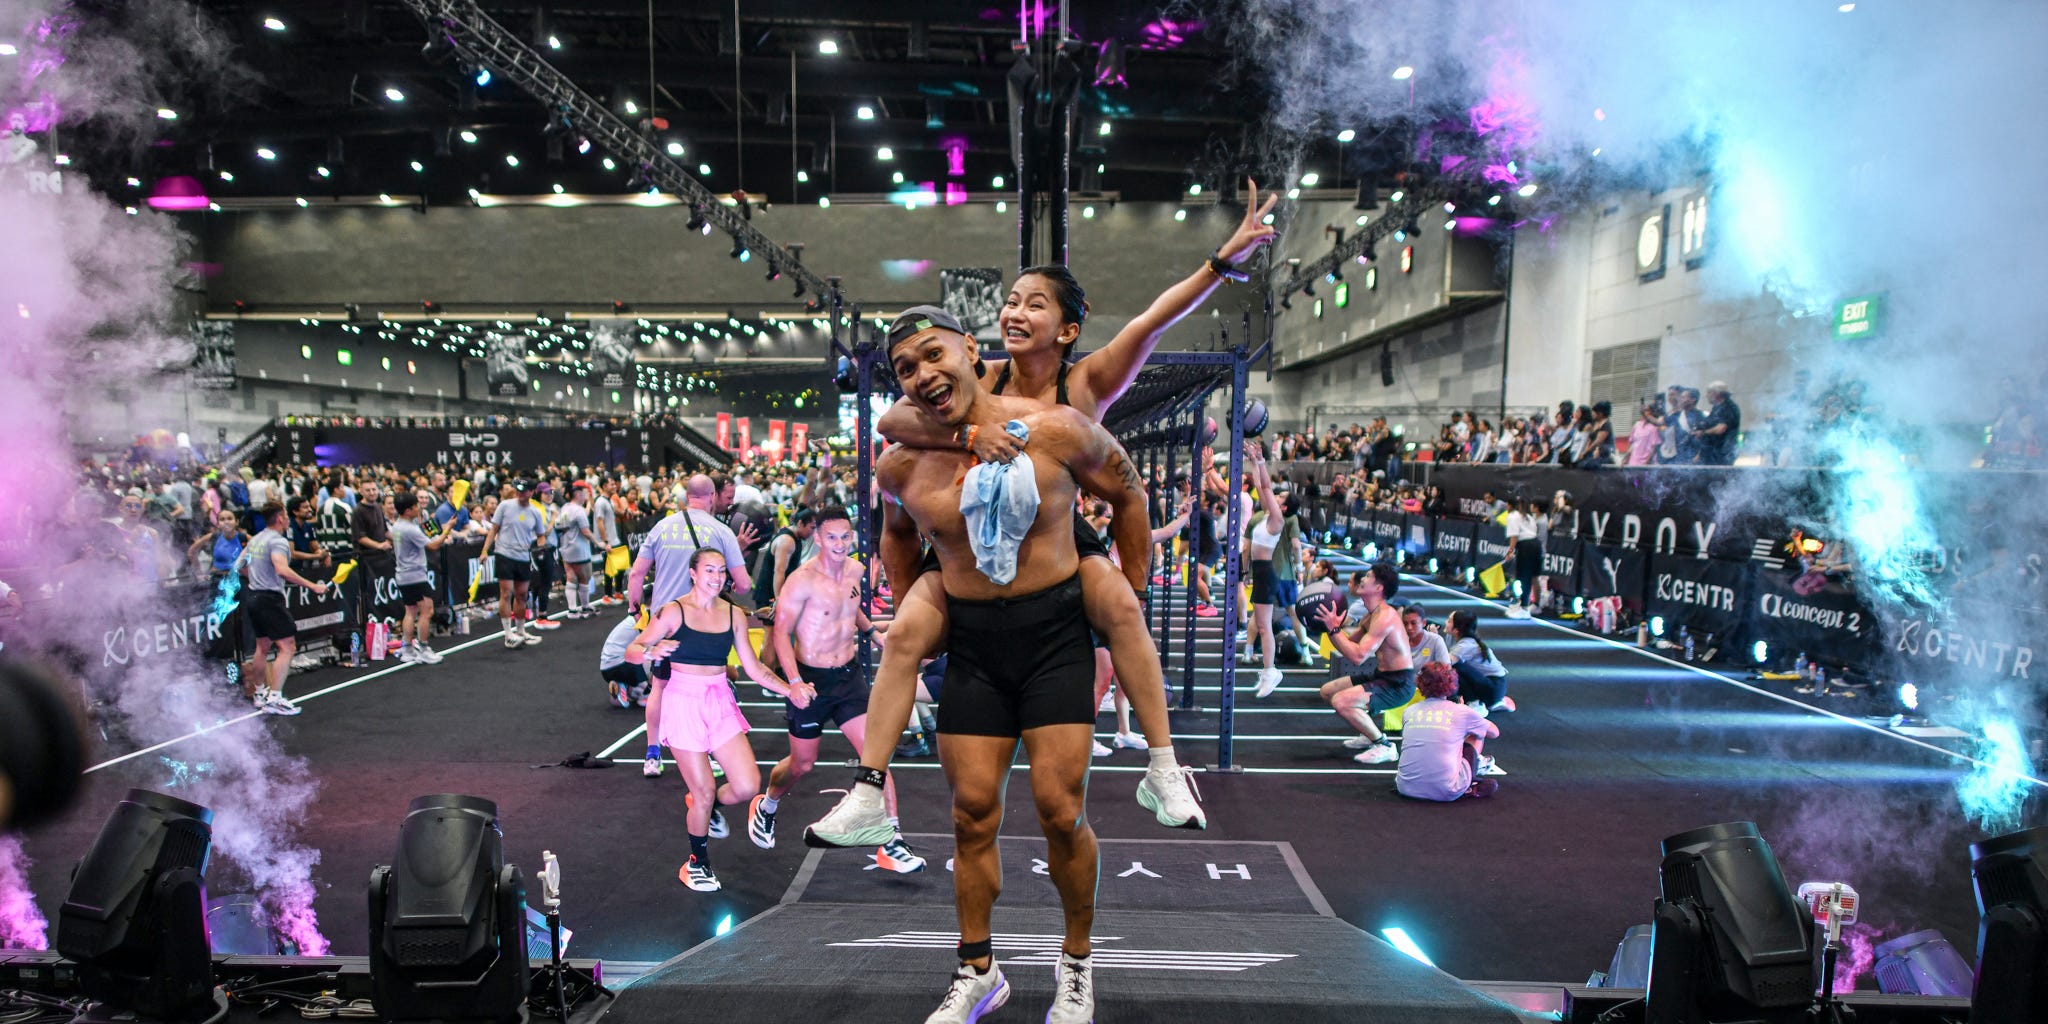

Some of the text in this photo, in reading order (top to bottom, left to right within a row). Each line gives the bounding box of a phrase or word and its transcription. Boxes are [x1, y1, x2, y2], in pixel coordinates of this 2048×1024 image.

[449, 433, 499, 447] BYD
[437, 450, 512, 465] HYROX
[1543, 552, 1575, 577] ENTR
[282, 579, 344, 609] YROX
[1300, 593, 1325, 607] CENTR
[1672, 579, 1735, 612] CENTR
[1782, 601, 1862, 633] concept 2
[133, 611, 223, 658] CENTR
[1924, 628, 2034, 680] CENTR
